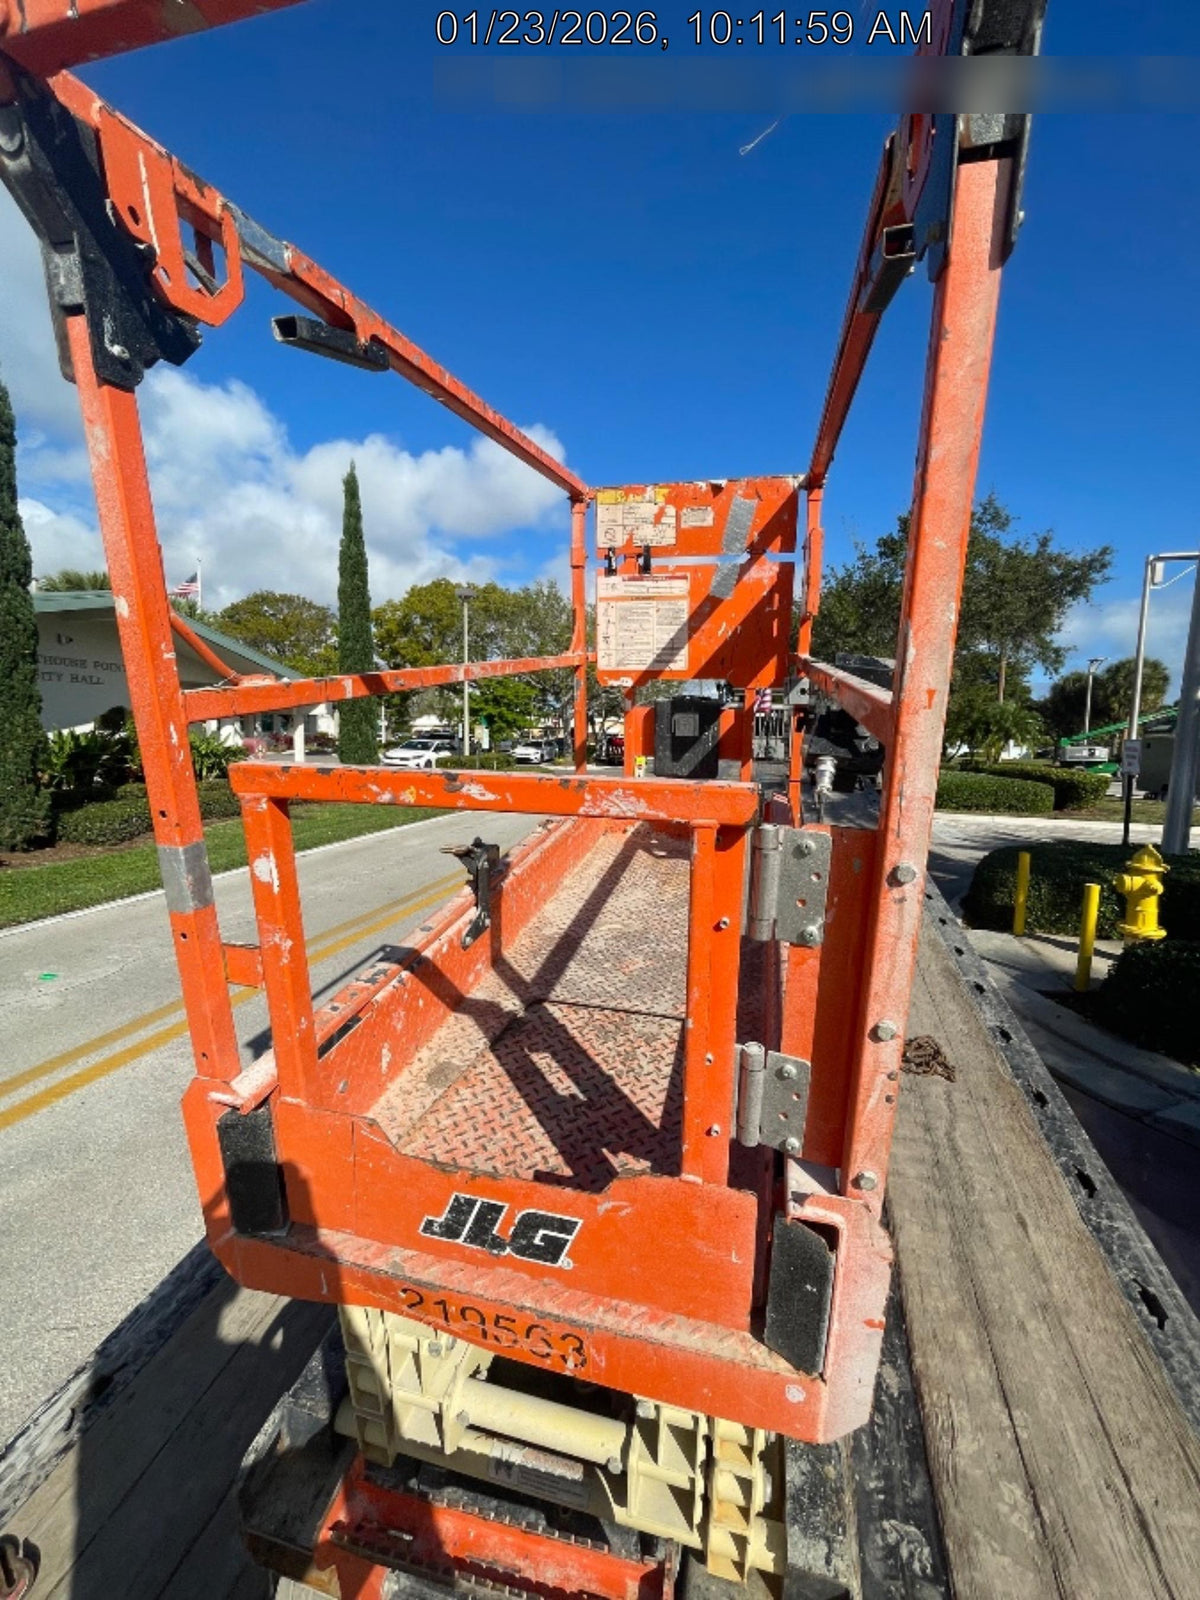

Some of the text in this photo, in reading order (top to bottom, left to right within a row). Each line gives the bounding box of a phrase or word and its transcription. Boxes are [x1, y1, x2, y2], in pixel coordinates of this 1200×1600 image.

[70, 673, 104, 685] HALL
[418, 1192, 583, 1268] JLG
[400, 1287, 588, 1369] 219563
